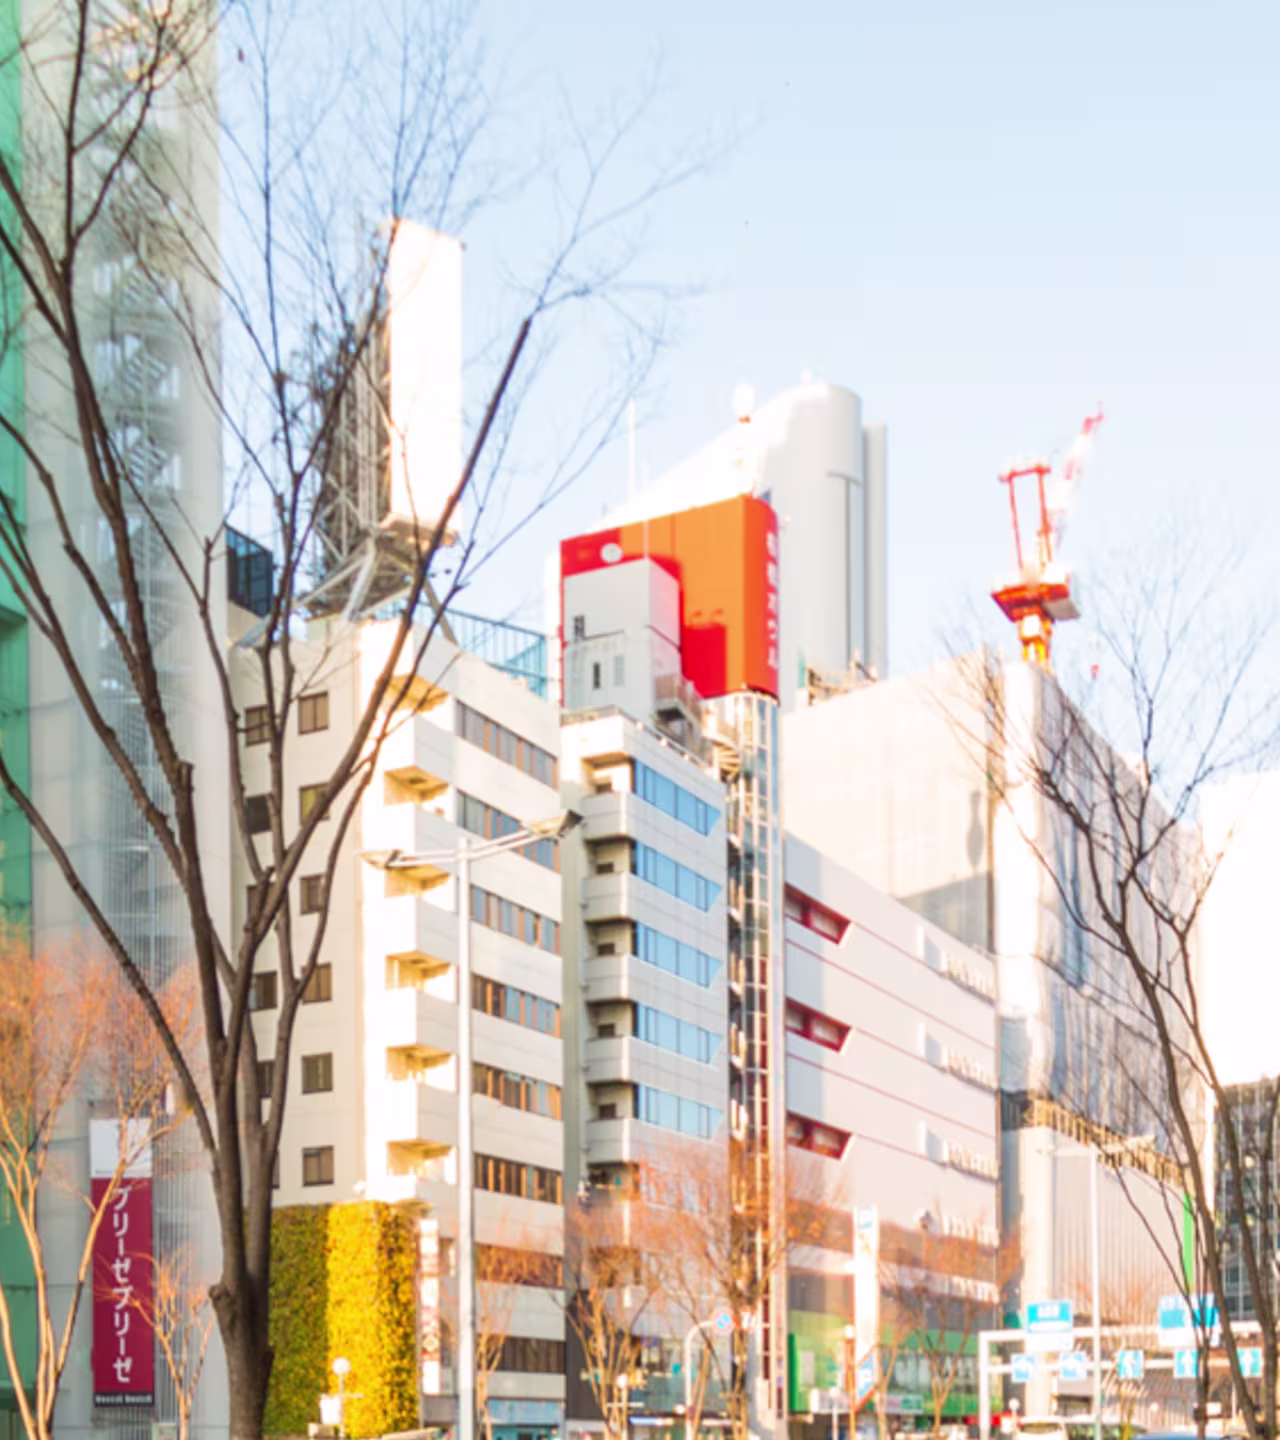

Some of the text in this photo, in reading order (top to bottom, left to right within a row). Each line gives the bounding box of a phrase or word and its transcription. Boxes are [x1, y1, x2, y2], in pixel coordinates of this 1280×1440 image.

[112, 1185, 134, 1383] ブリーゼブリーゼ
